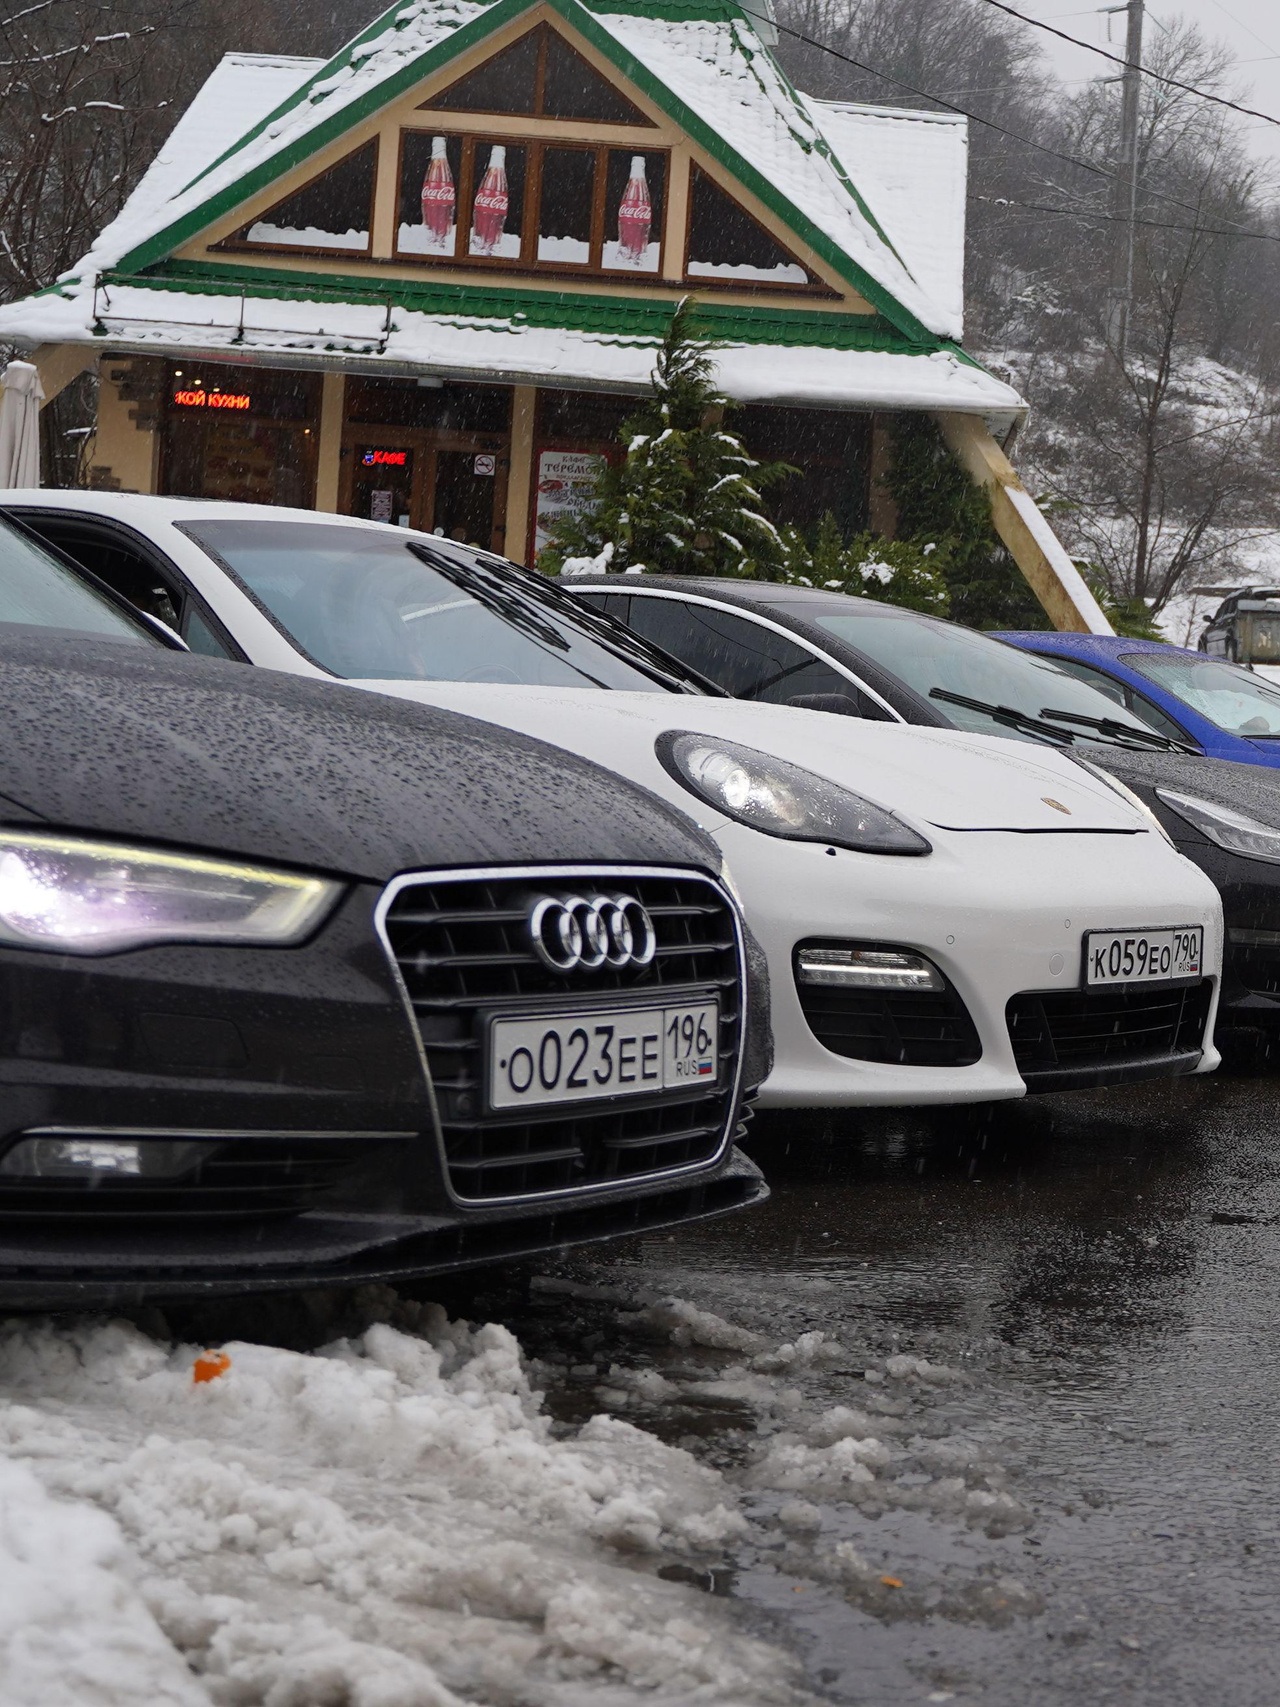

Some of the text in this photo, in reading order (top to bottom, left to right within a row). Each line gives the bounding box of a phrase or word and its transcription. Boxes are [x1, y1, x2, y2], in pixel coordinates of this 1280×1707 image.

[207, 393, 250, 409] КУХНИ
[374, 450, 406, 465] КАФЕ
[1094, 933, 1197, 978] К059ЕО 790
[1179, 962, 1190, 972] RUS
[508, 1013, 709, 1093] О023ЕЕ 196
[676, 1060, 697, 1077] RUS
